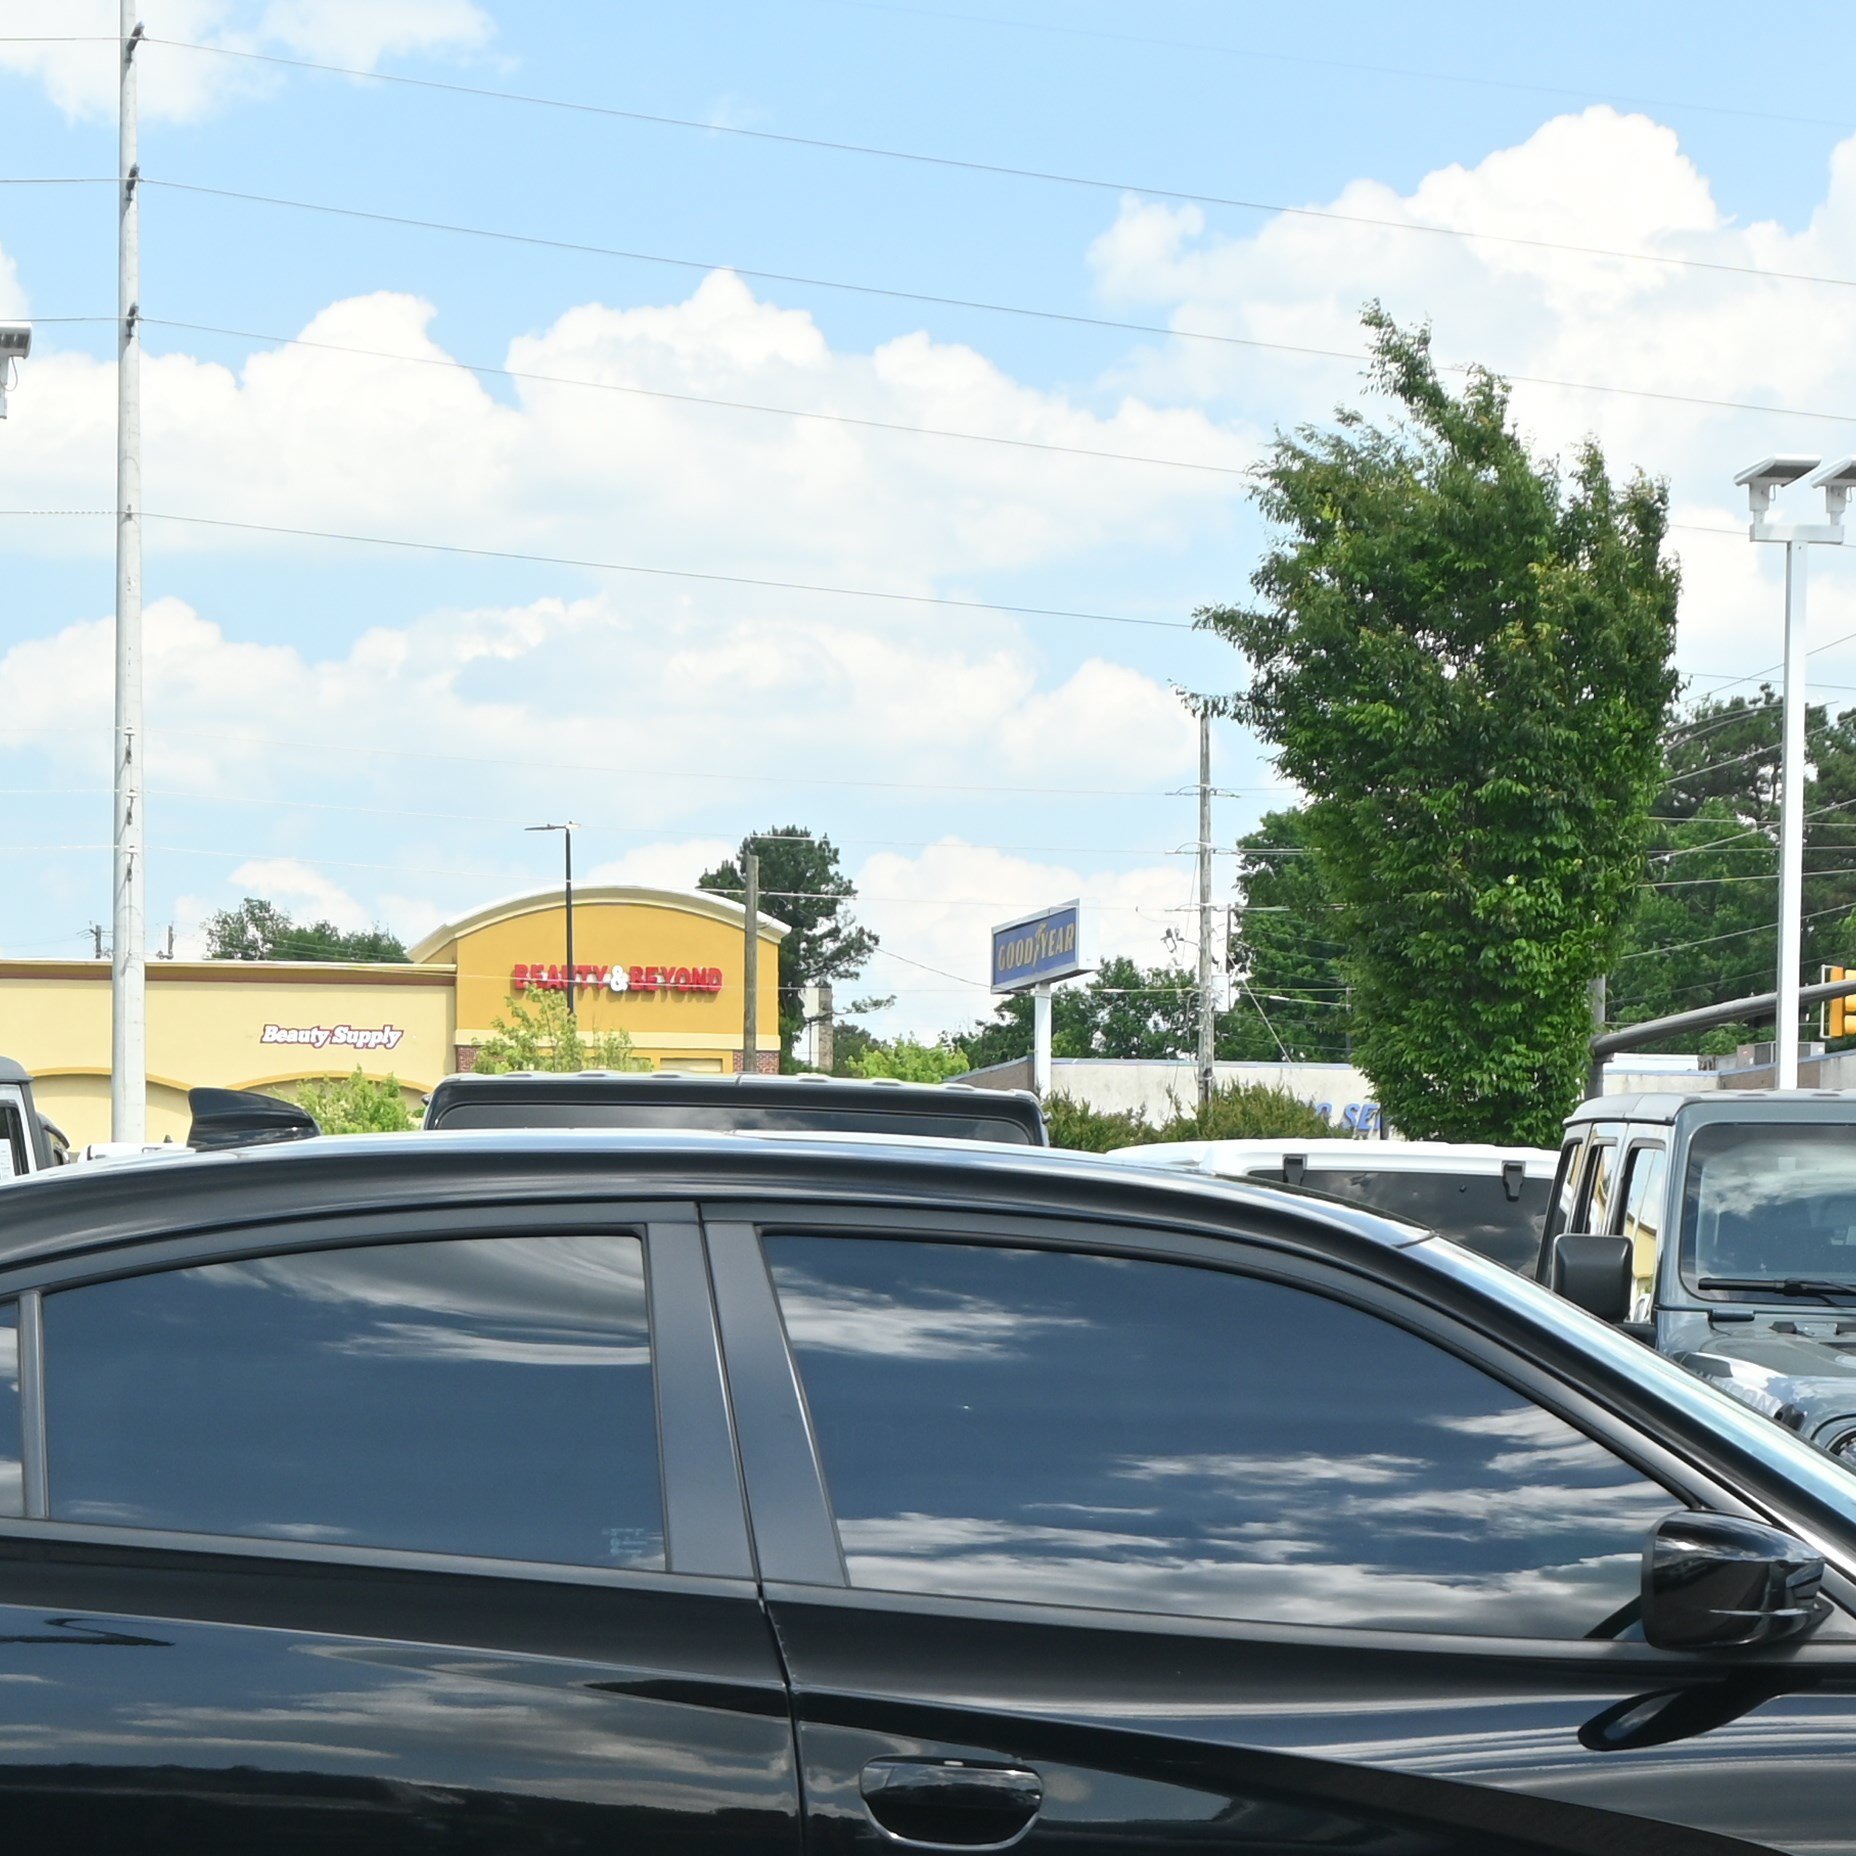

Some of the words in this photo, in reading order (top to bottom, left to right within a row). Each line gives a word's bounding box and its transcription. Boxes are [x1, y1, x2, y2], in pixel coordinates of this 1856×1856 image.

[610, 965, 629, 992] &
[629, 966, 723, 992] BEYOND
[260, 1024, 331, 1049] Beauty
[329, 1024, 404, 1049] Supply
